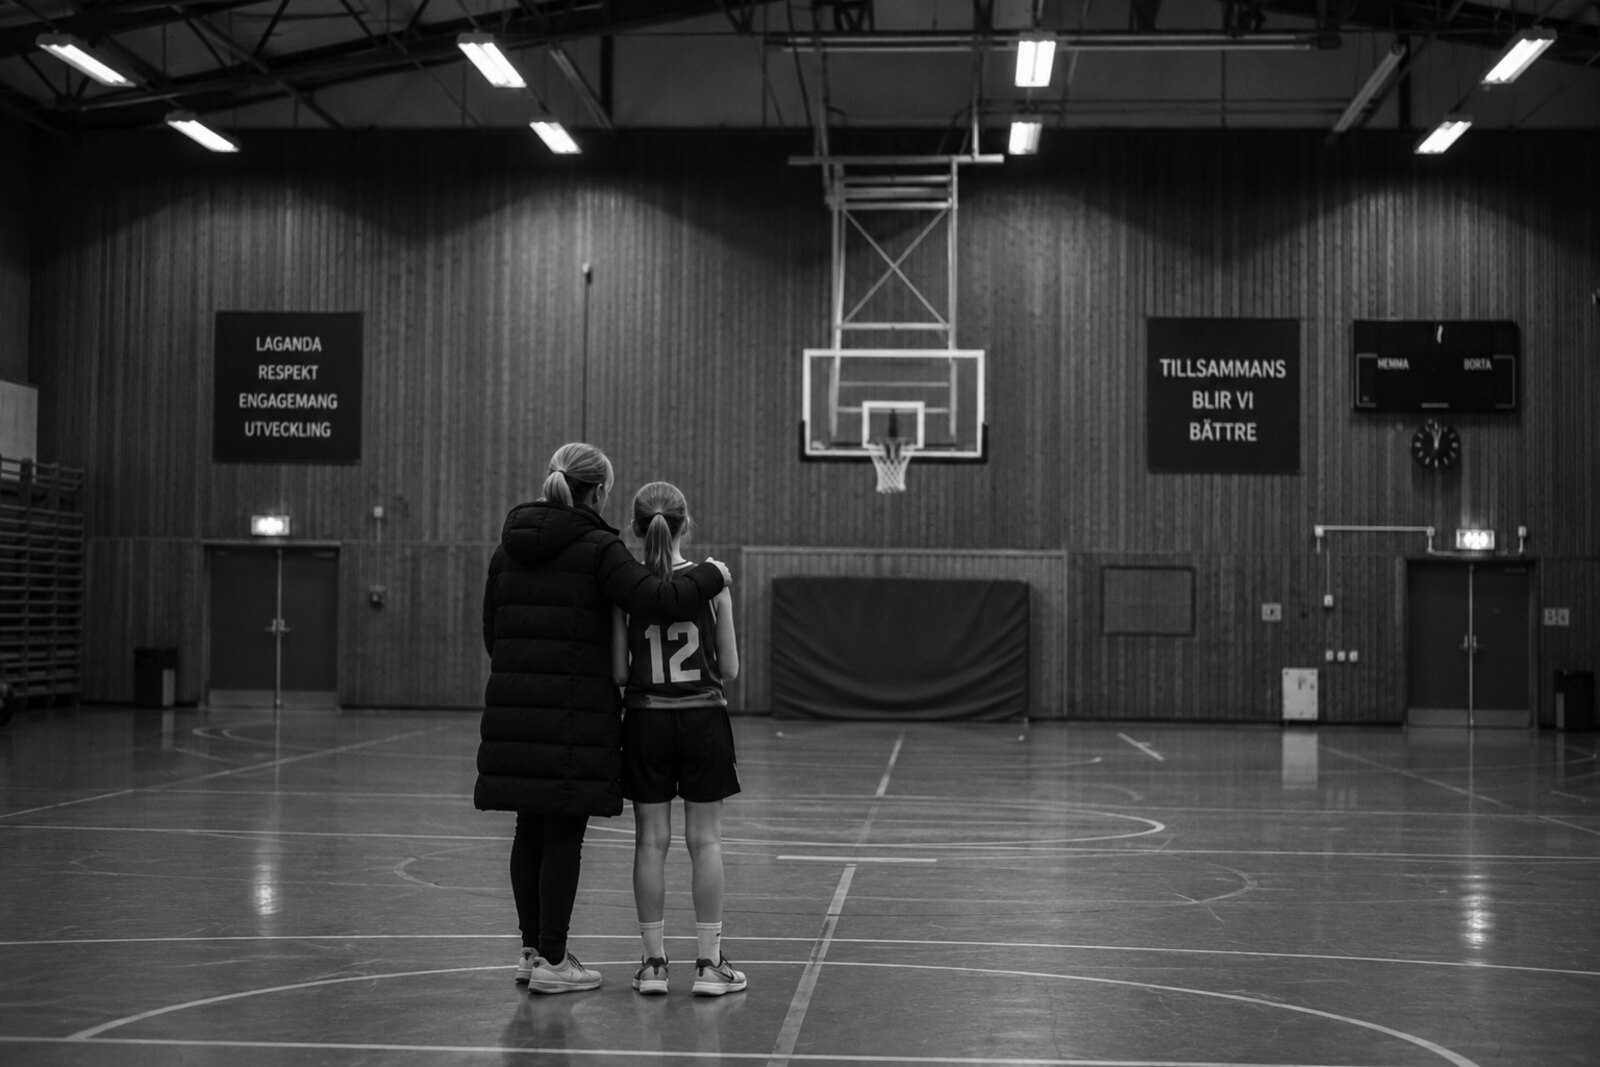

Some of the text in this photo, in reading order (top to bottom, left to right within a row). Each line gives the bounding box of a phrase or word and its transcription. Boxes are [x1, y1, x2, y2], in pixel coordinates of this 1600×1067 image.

[256, 336, 322, 352] LAGANDA
[258, 364, 319, 380] RESPEKT
[1159, 358, 1287, 378] TILLSAMMANS
[1464, 358, 1492, 370] BORTA
[239, 393, 338, 409] ENGAGEMANG
[1192, 390, 1254, 410] BLIR VI
[245, 421, 331, 438] UTVECKLING
[1189, 418, 1257, 441] BÄTTRE
[644, 621, 701, 684] 12
